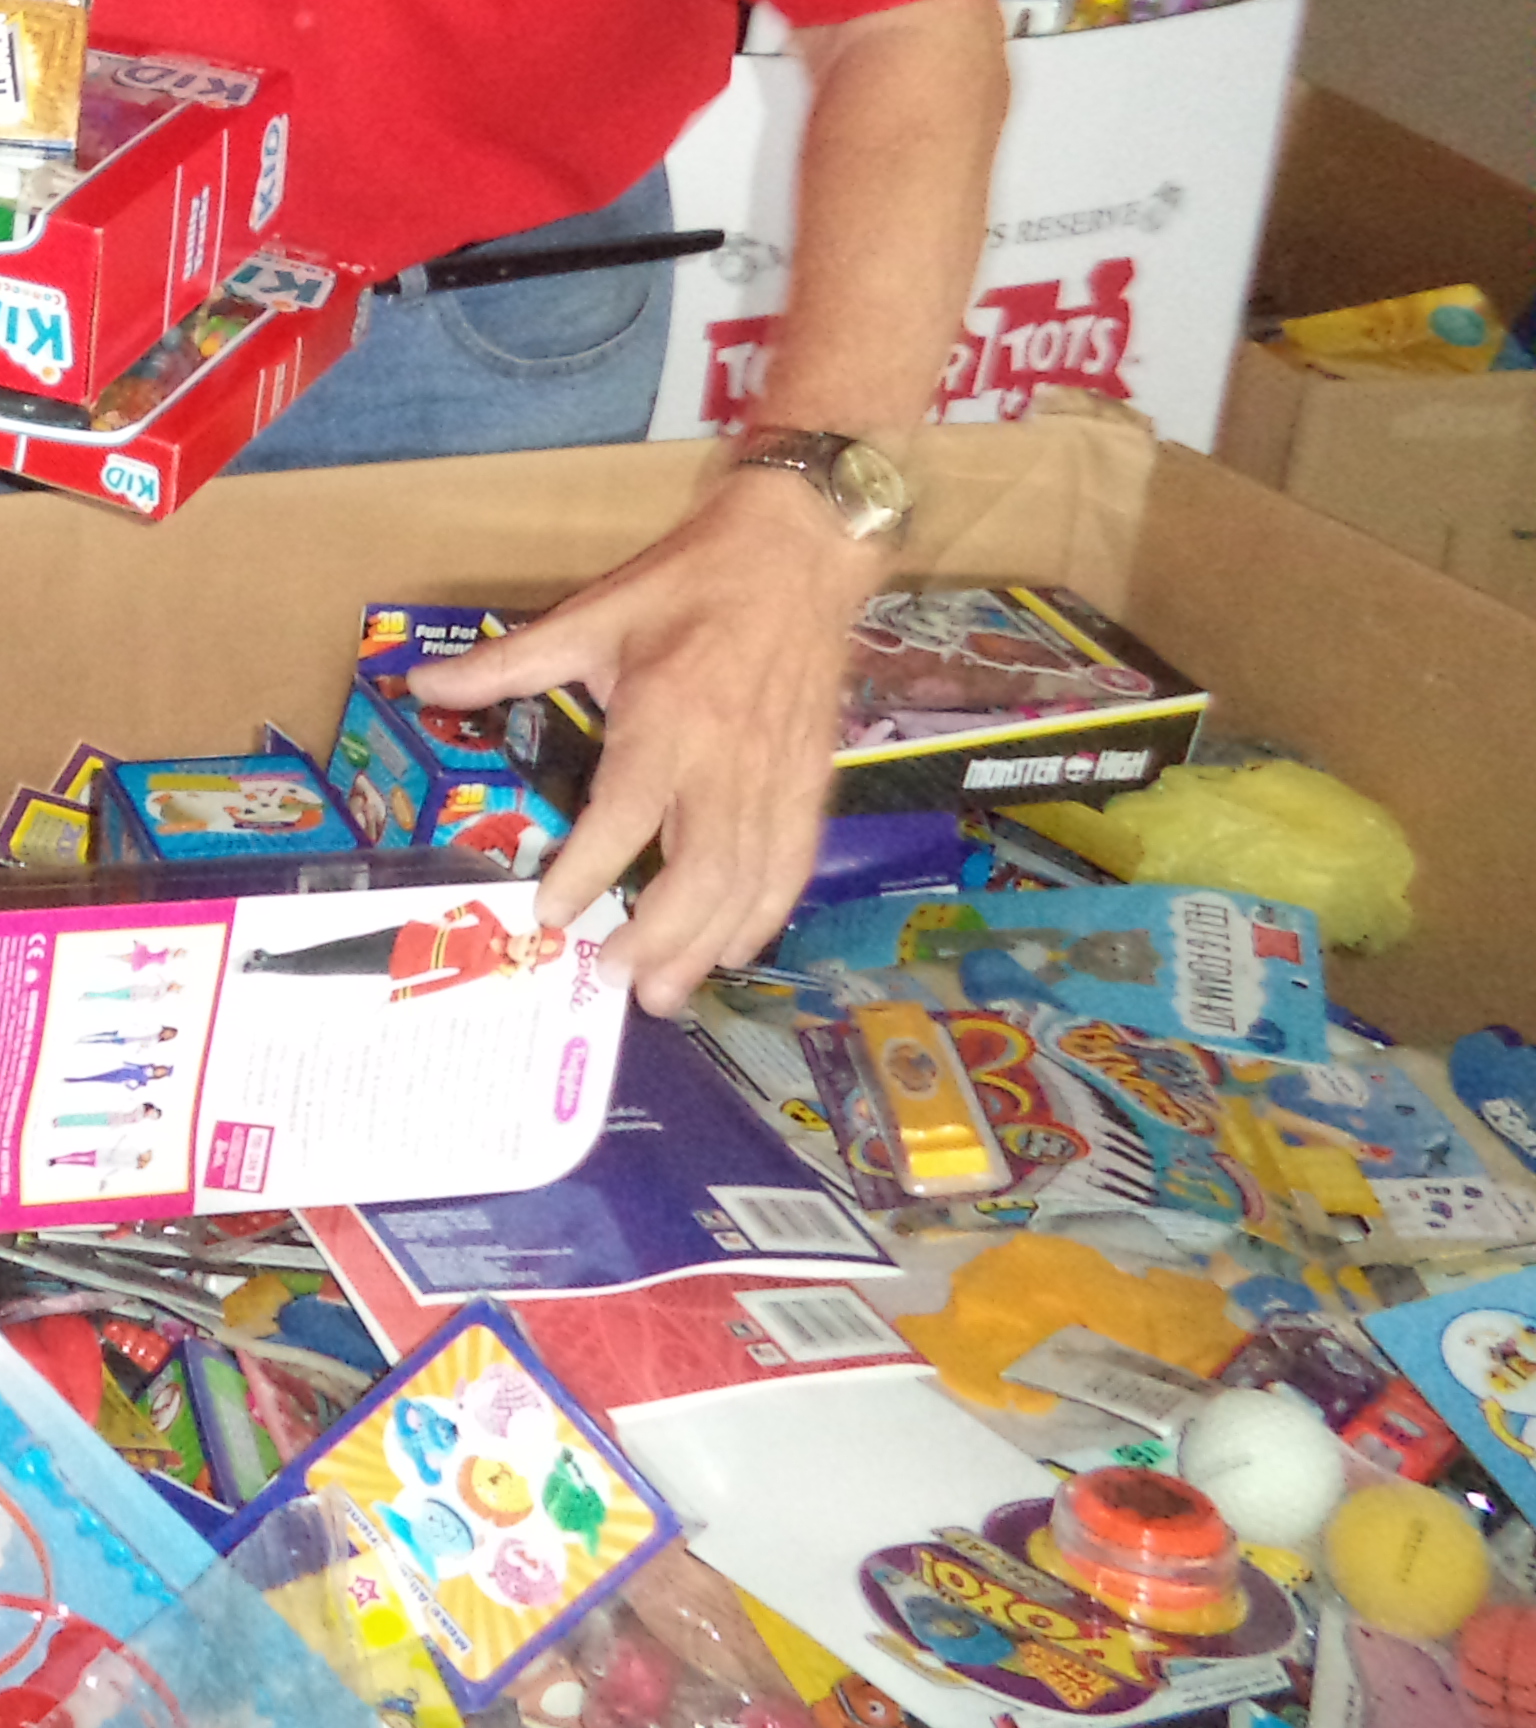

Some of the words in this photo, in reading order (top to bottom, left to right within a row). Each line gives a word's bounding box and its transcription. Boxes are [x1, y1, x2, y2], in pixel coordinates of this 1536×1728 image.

[125, 63, 248, 104] KID
[1001, 314, 1116, 376] TOTS
[106, 466, 157, 503] KID
[414, 625, 448, 639] Fun
[450, 626, 479, 640] For
[962, 754, 1065, 790] MONSTER
